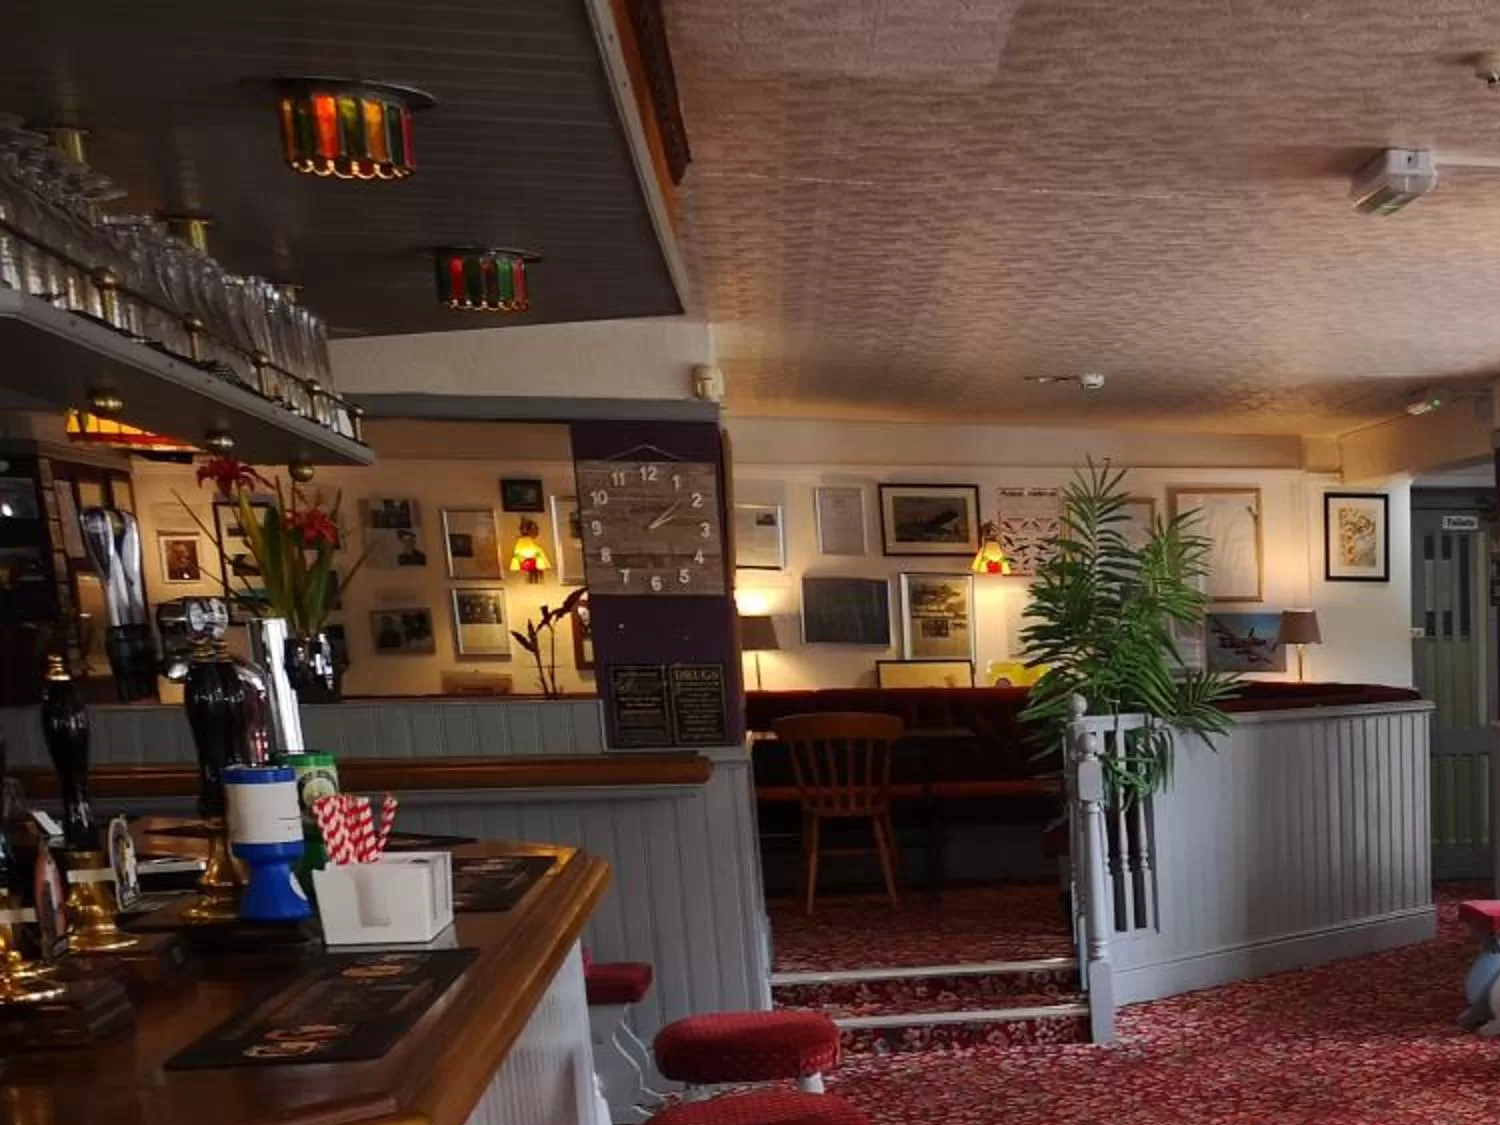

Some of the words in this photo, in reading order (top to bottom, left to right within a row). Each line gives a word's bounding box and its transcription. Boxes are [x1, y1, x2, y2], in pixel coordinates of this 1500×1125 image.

[611, 471, 625, 487] 11
[639, 466, 658, 481] 12
[672, 474, 681, 491] 1
[590, 489, 609, 507] 10
[691, 493, 704, 508] 2
[591, 520, 602, 536] 9
[701, 523, 711, 538] 3
[601, 547, 611, 563] 8
[693, 549, 704, 564] 4
[619, 568, 631, 584] 7
[679, 568, 690, 583] 5
[651, 576, 662, 591] 6
